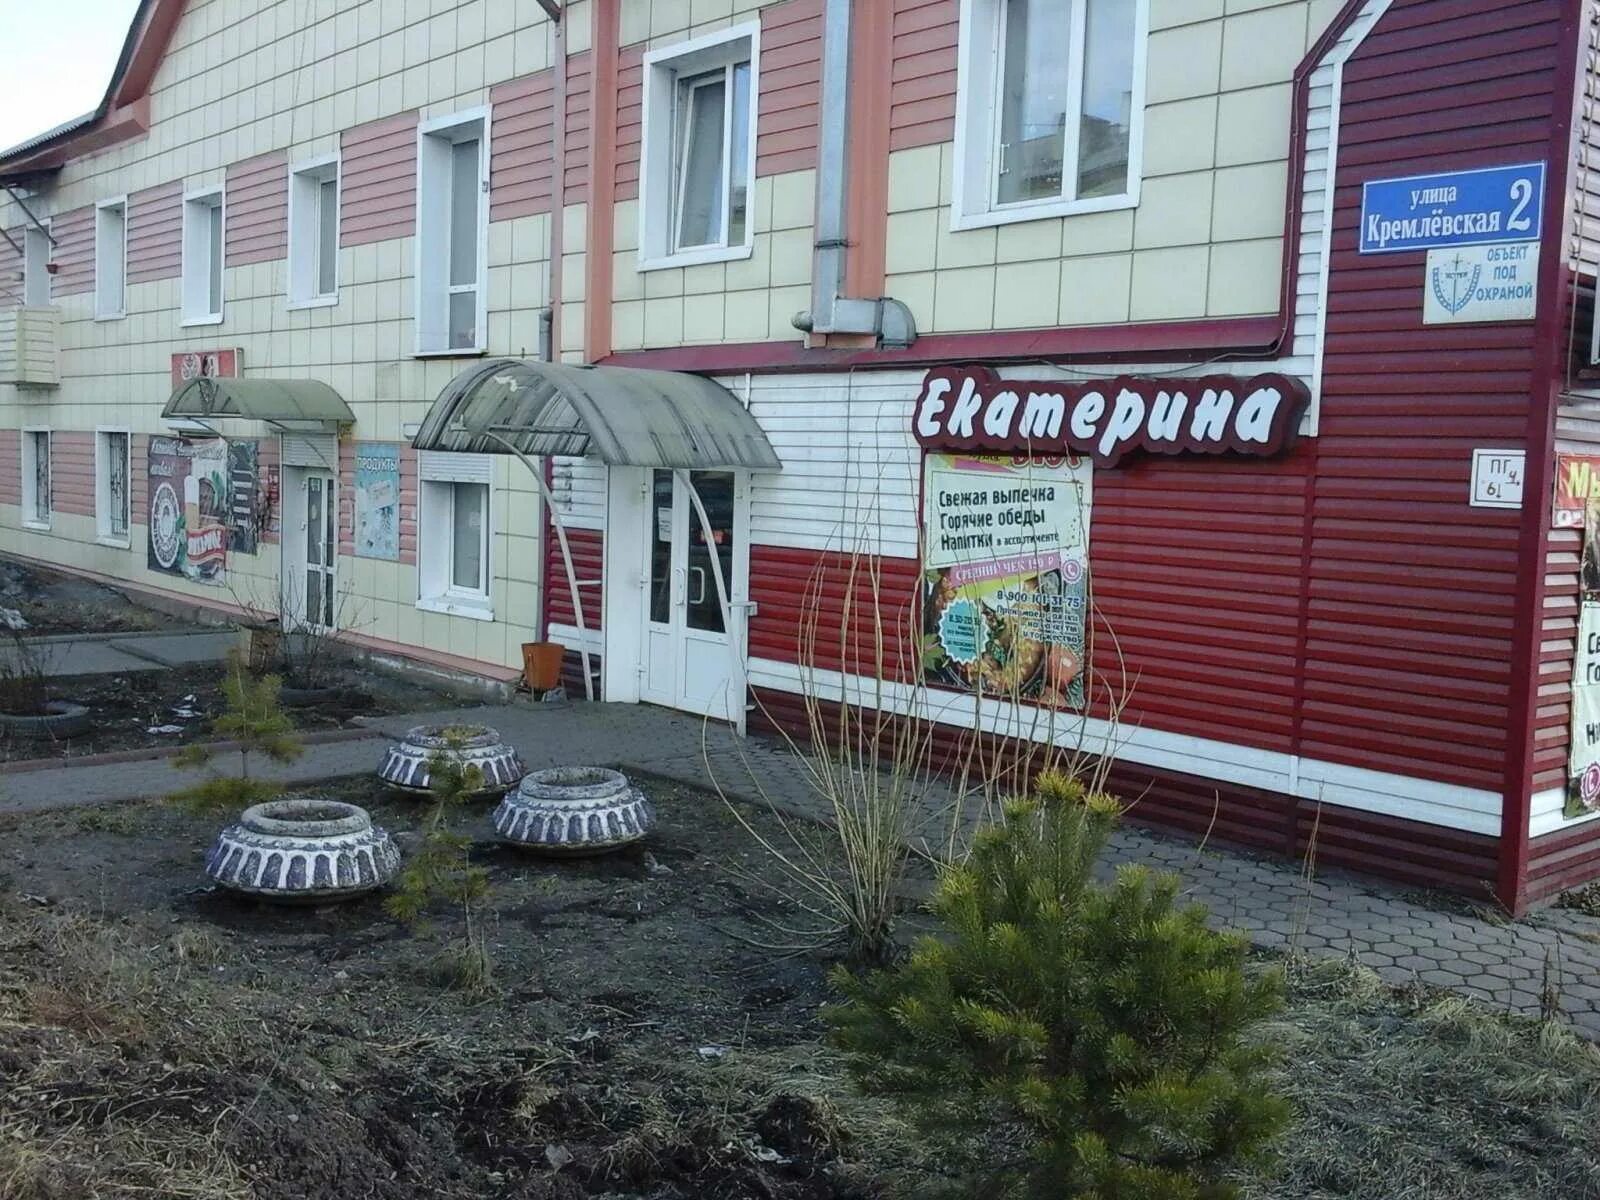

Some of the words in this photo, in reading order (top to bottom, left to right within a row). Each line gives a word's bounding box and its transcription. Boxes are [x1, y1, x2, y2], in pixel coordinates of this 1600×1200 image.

[1410, 186, 1457, 210] улица
[1506, 178, 1533, 231] 2
[1367, 209, 1501, 247] Кремлёвская
[1487, 245, 1529, 262] ОБЪЕКТ
[1493, 265, 1517, 281] ПОД
[1476, 283, 1533, 301] ОХРАНОЙ
[917, 376, 1282, 457] Екатерина
[939, 490, 987, 508] Свежая
[992, 486, 1055, 505] выпечка
[940, 513, 993, 532] Горячие
[998, 508, 1045, 527] обеды
[941, 534, 993, 551] Напитки
